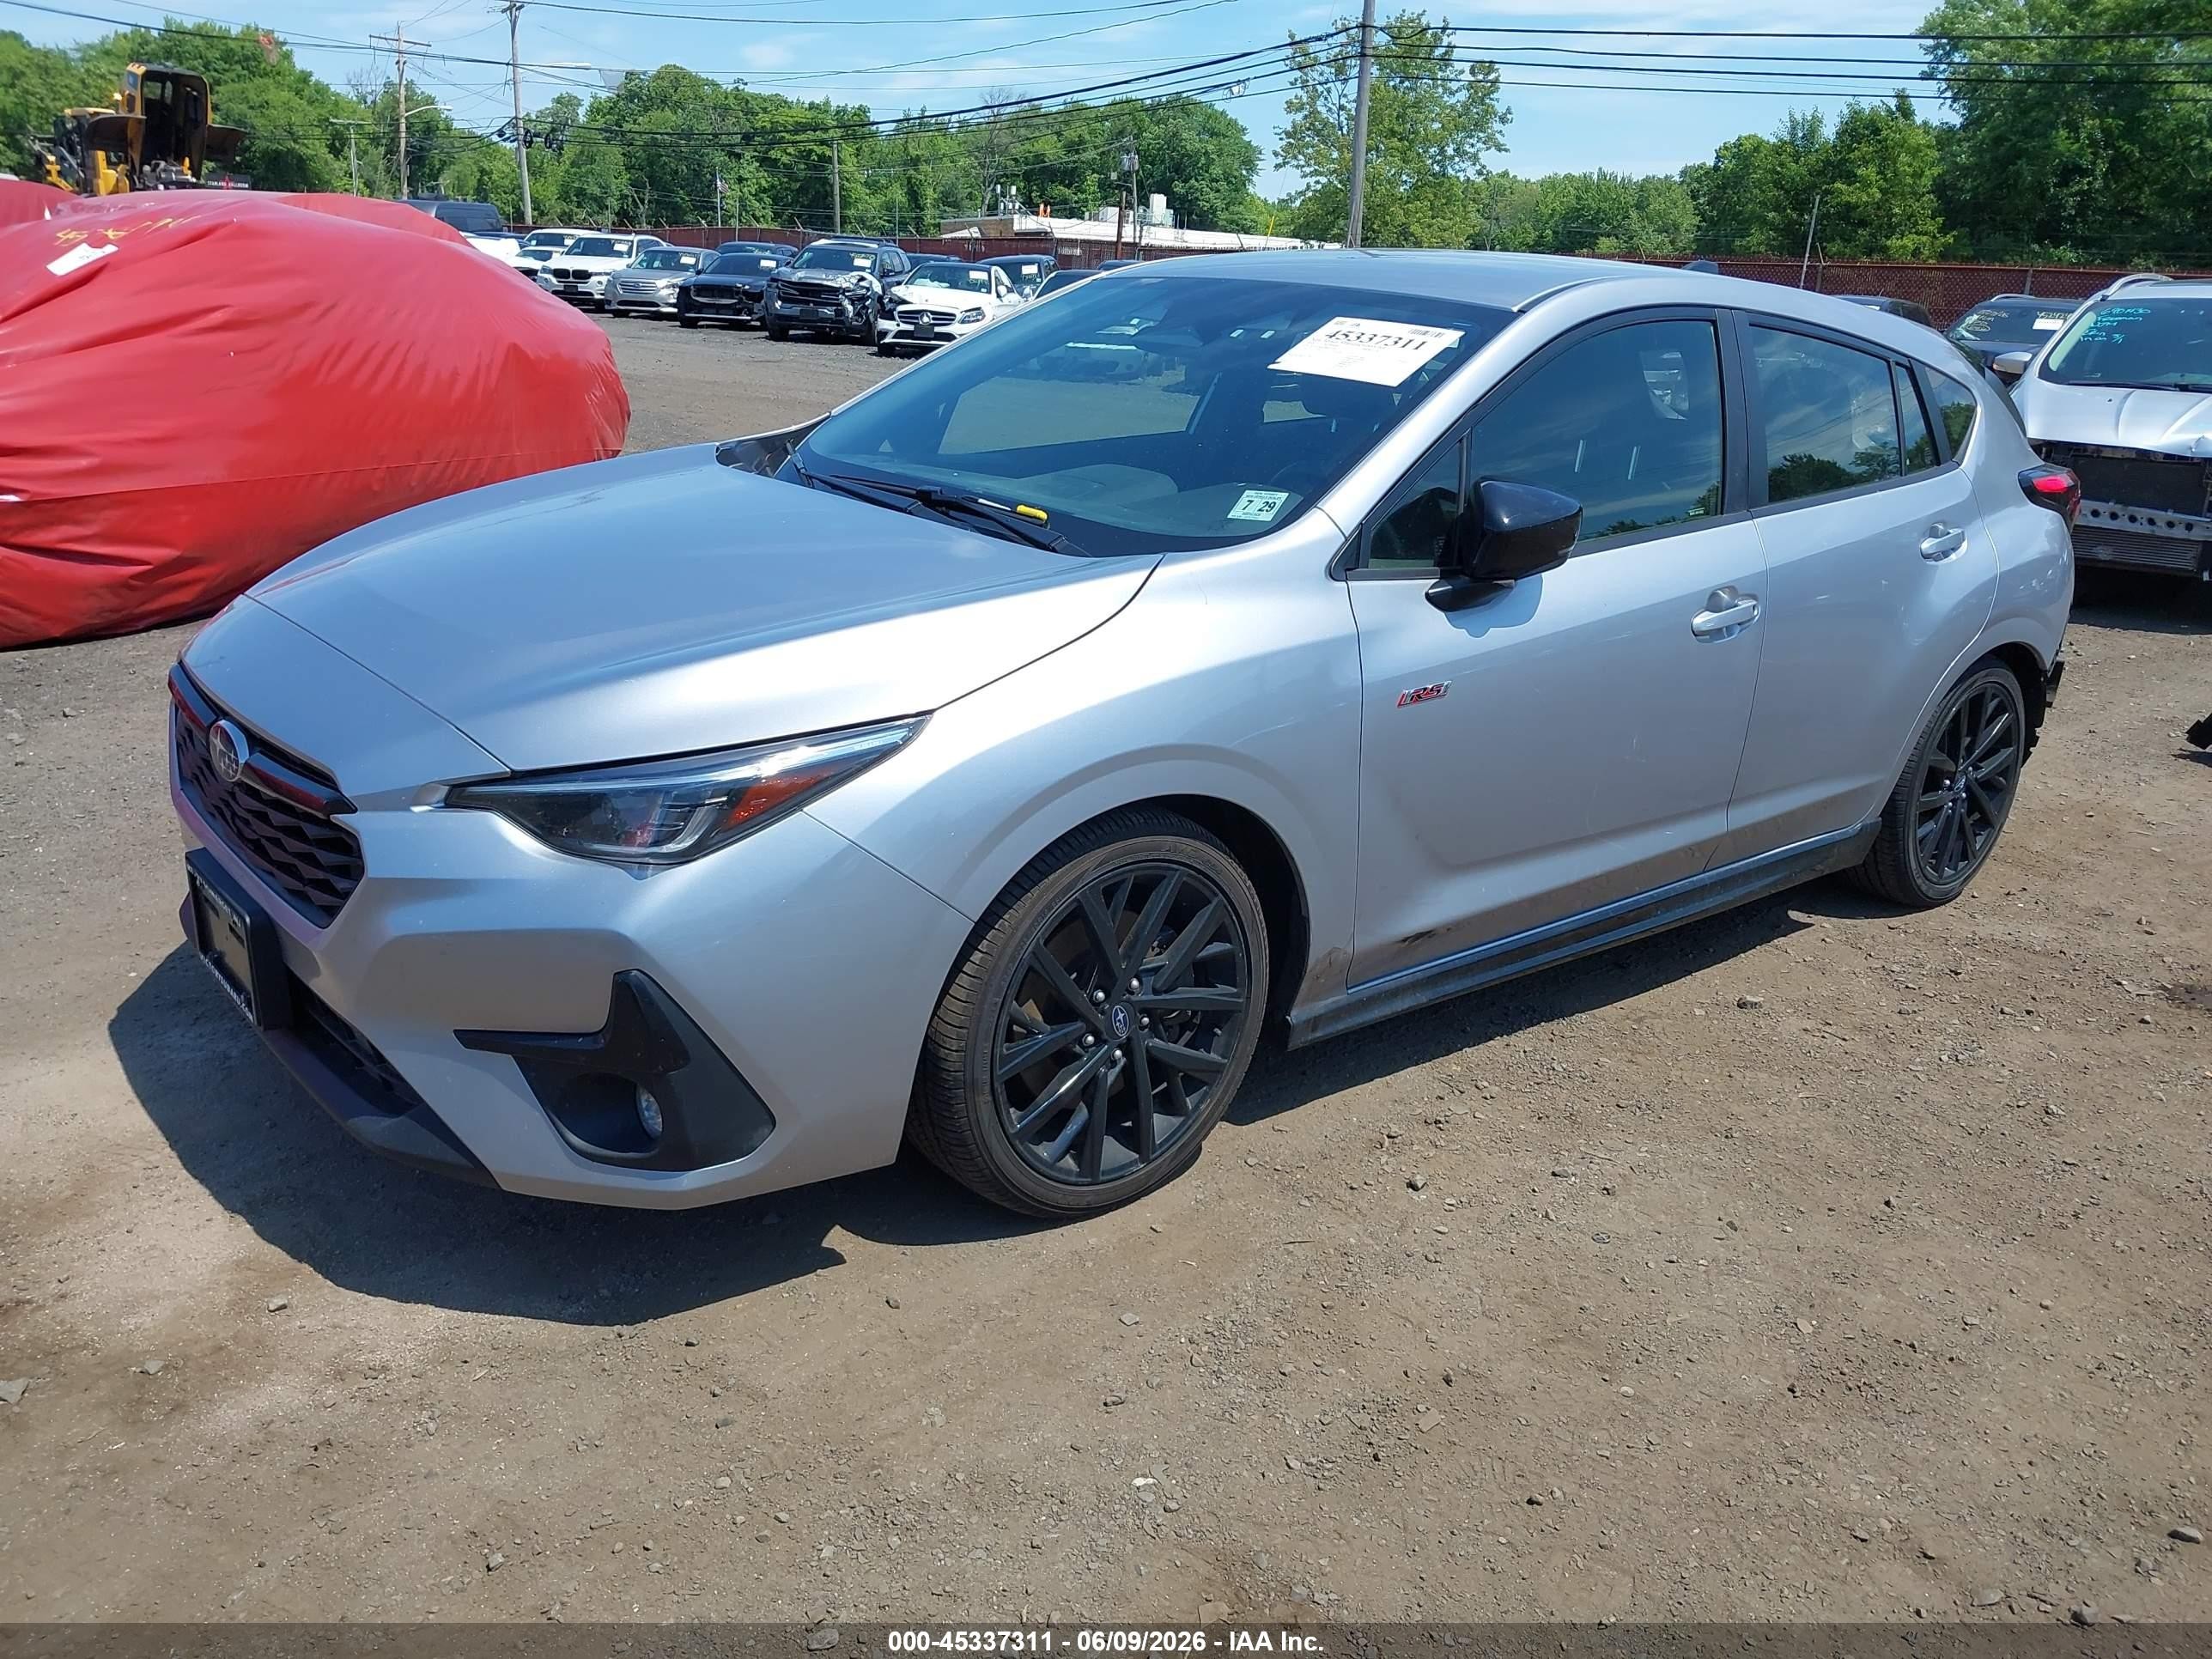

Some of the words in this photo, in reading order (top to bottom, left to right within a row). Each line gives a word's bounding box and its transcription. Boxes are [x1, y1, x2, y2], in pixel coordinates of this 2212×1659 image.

[1324, 329, 1428, 350] 45337311
[1241, 499, 1255, 511] 7
[1256, 501, 1277, 513] 29
[1407, 681, 1447, 703] RS
